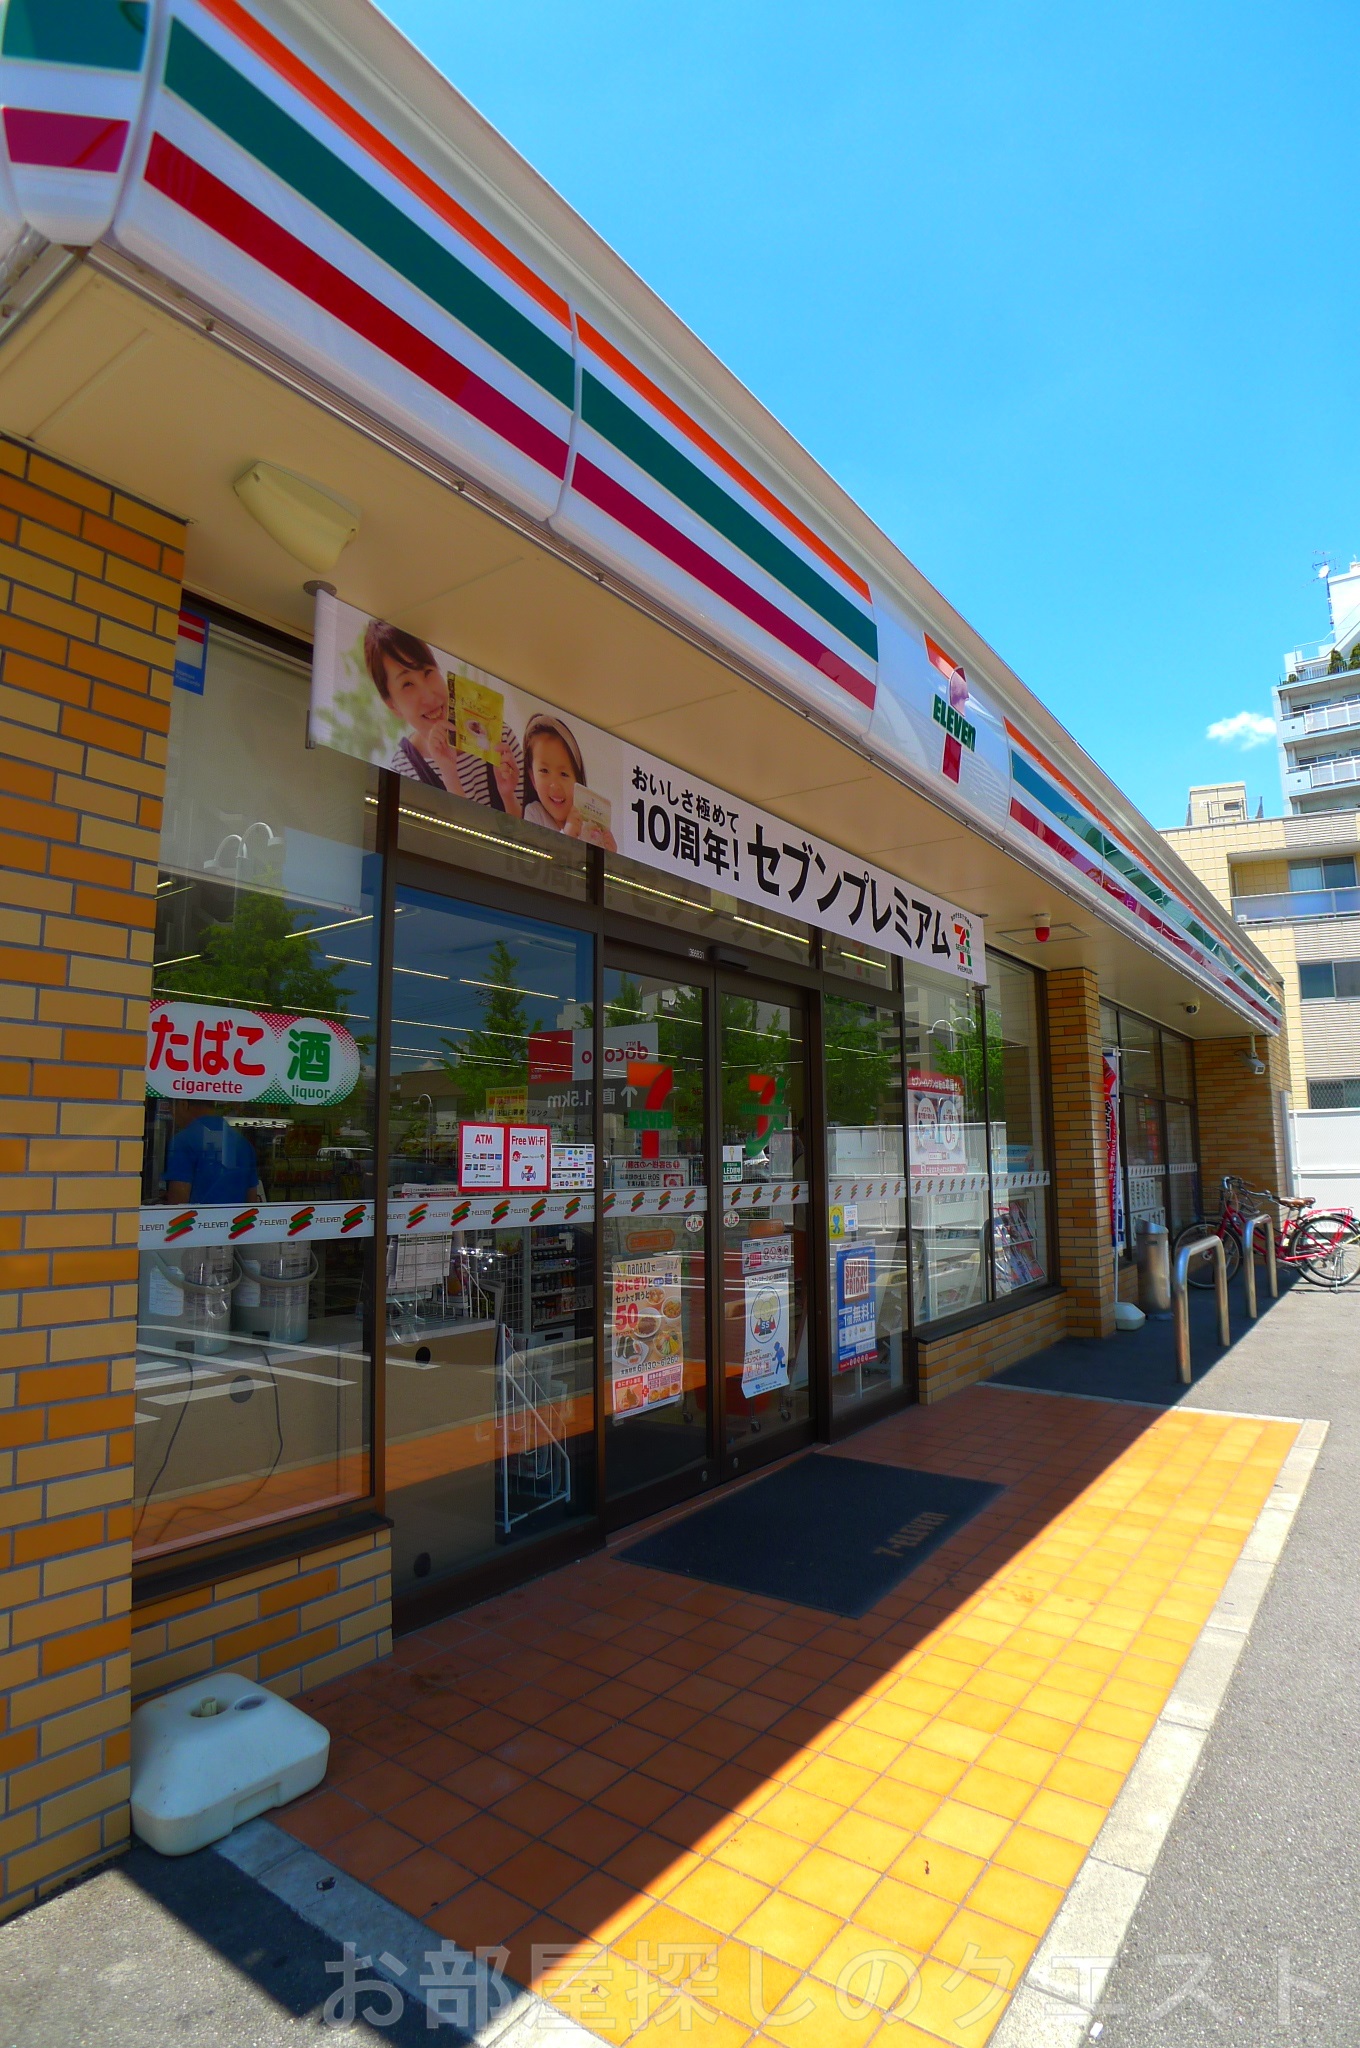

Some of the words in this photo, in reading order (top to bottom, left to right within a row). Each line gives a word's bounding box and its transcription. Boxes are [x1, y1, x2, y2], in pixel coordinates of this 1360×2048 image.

[631, 765, 740, 834] おいしさ極めて
[747, 823, 951, 959] セブンプレミアム
[957, 964, 974, 976] PREMIUM
[149, 1013, 266, 1076] たばこ
[287, 1028, 332, 1083] 酒
[172, 1077, 243, 1095] cigarette
[291, 1084, 332, 1100] liquor
[474, 1133, 493, 1145] ATM
[511, 1135, 527, 1146] Free
[527, 1135, 546, 1146] Wi-Fi
[845, 1276, 868, 1296] FRIDAY
[615, 1290, 650, 1304] セットで買うと
[615, 1303, 639, 1331] 50
